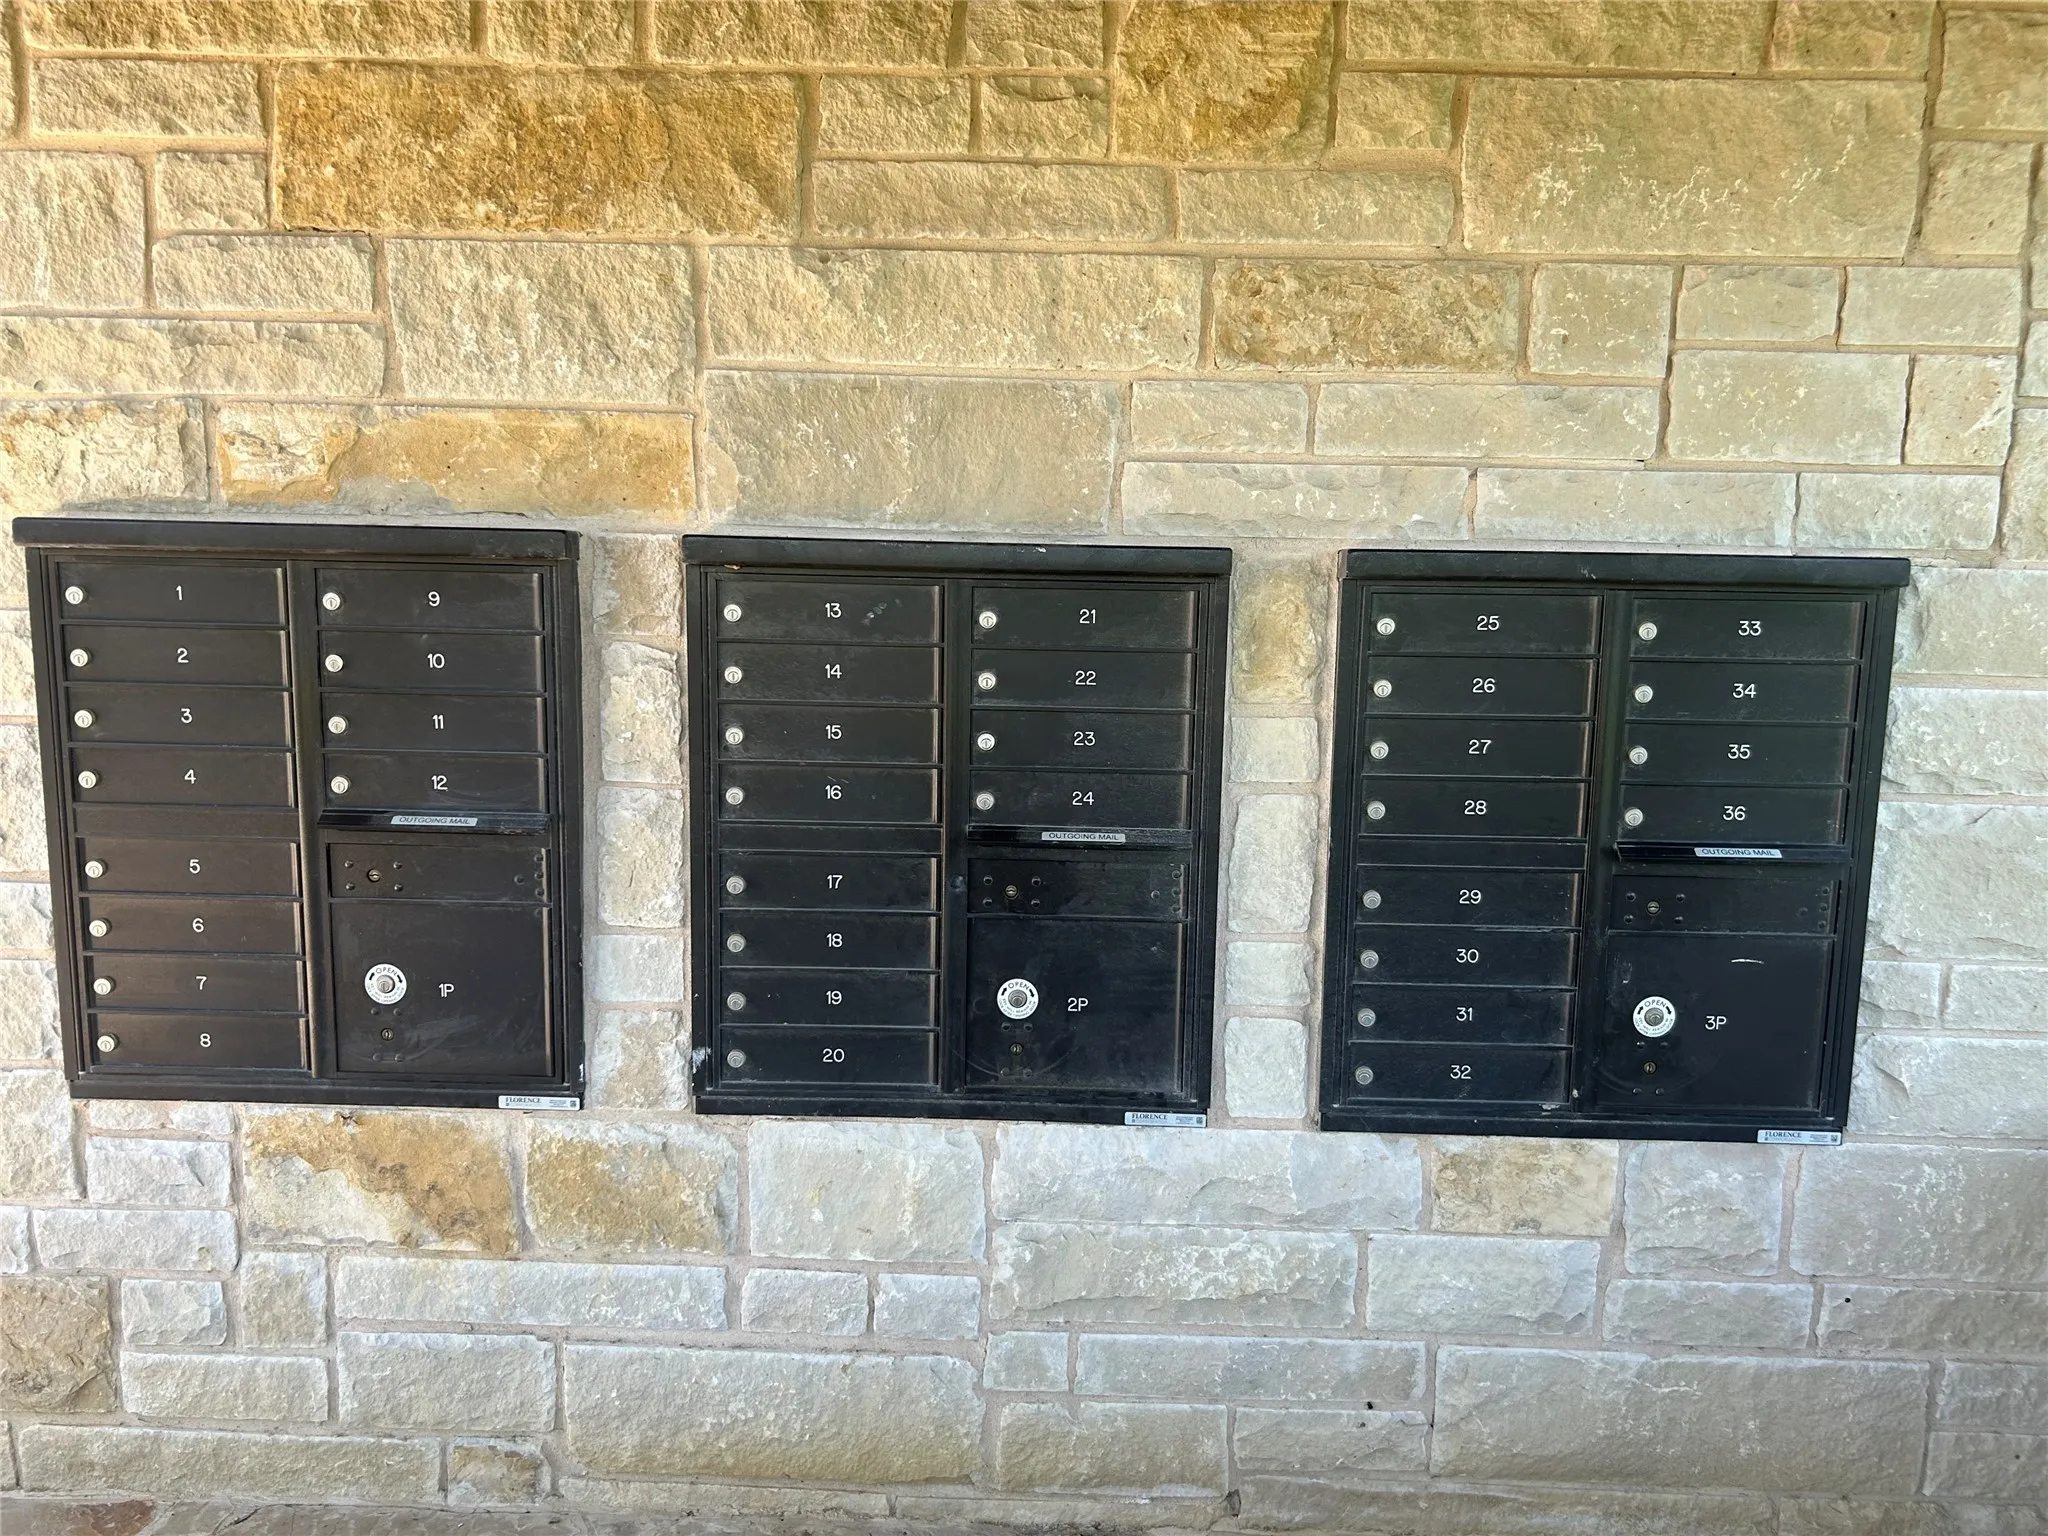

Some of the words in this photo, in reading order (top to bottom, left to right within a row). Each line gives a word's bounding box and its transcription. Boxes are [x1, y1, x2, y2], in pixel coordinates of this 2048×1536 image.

[175, 585, 183, 601] 1
[427, 591, 441, 607] 9
[824, 602, 842, 619] 13
[1079, 608, 1096, 624] 21
[1476, 615, 1500, 631] 25
[1738, 620, 1762, 637] 33
[177, 647, 190, 664] 2
[427, 653, 445, 669] 10
[824, 663, 843, 679] 14
[1075, 670, 1097, 686] 22
[1472, 677, 1496, 694] 26
[1732, 682, 1757, 699] 34
[180, 707, 193, 724] 3
[432, 714, 444, 730] 11
[825, 724, 842, 740] 15
[1073, 731, 1096, 747] 23
[1468, 739, 1492, 755] 27
[1727, 743, 1751, 760] 35
[184, 769, 197, 785] 4
[431, 774, 449, 790] 12
[824, 784, 842, 800] 16
[1072, 790, 1095, 806] 24
[1464, 799, 1487, 816] 28
[1722, 805, 1746, 821] 36
[399, 816, 447, 824] OUTGOING
[449, 817, 470, 825] MAIL
[1048, 832, 1096, 840] OUTGOING
[1701, 848, 1751, 856] OUTGOING
[189, 858, 201, 874] 5
[826, 874, 843, 889] 17
[1458, 889, 1482, 905] 29
[192, 917, 205, 933] 6
[826, 932, 843, 948] 18
[1455, 948, 1480, 964] 30
[376, 966, 397, 976] OPEN
[195, 975, 208, 991] 7
[438, 983, 455, 998] 1P
[1008, 981, 1029, 990] OPEN
[825, 990, 843, 1005] 19
[1067, 997, 1089, 1012] 2P
[1644, 999, 1666, 1008] OPEN
[1455, 1006, 1473, 1022] 31
[1704, 1015, 1727, 1031] 3P
[199, 1033, 212, 1048] 8
[822, 1048, 845, 1063] 20
[1449, 1064, 1472, 1080] 32
